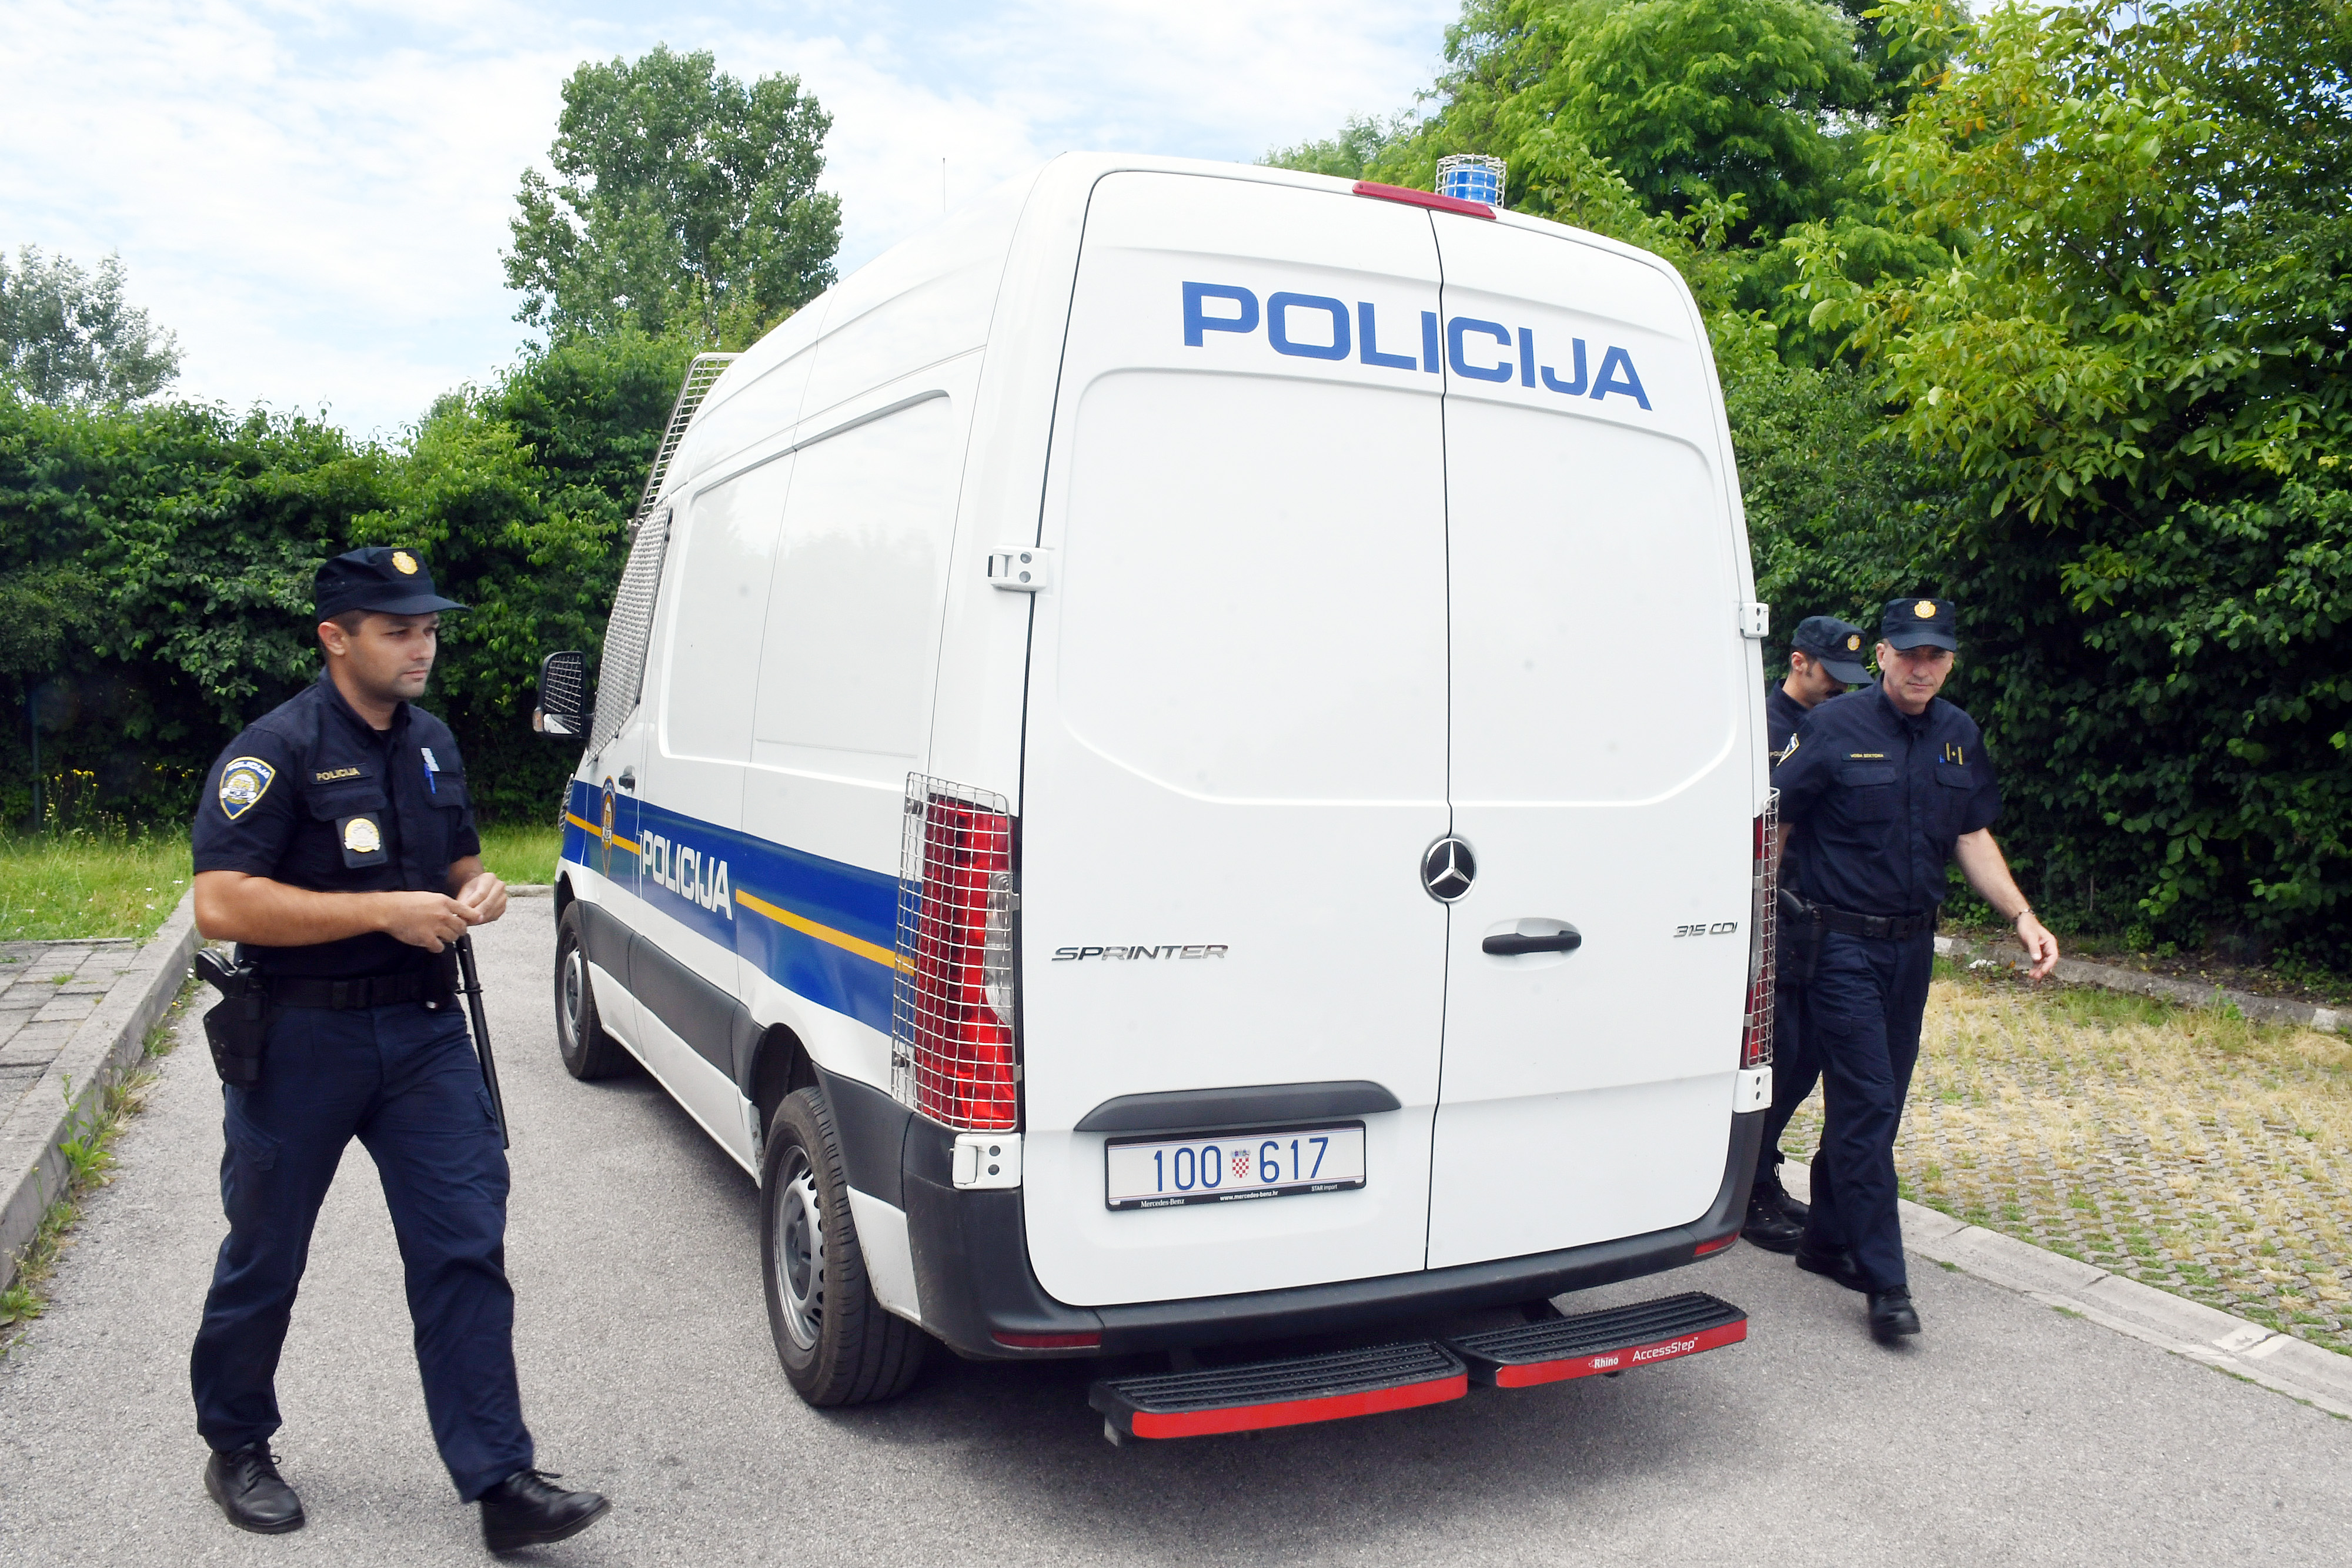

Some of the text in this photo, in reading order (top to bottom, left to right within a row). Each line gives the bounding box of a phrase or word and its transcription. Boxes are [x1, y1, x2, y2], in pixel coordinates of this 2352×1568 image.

[1182, 281, 1653, 412] POLICIJA
[316, 767, 361, 781] POLICIJA
[642, 829, 733, 921] POLICIJA
[1673, 921, 1738, 938] 315 CDI
[1051, 944, 1228, 961] SPRINTER
[1154, 1137, 1329, 1192] 100 617
[1140, 1198, 1185, 1208] Mercedes-Benz
[1220, 1190, 1279, 1201] www.mercedes-benz.hr
[1594, 1357, 1619, 1369] Rhino
